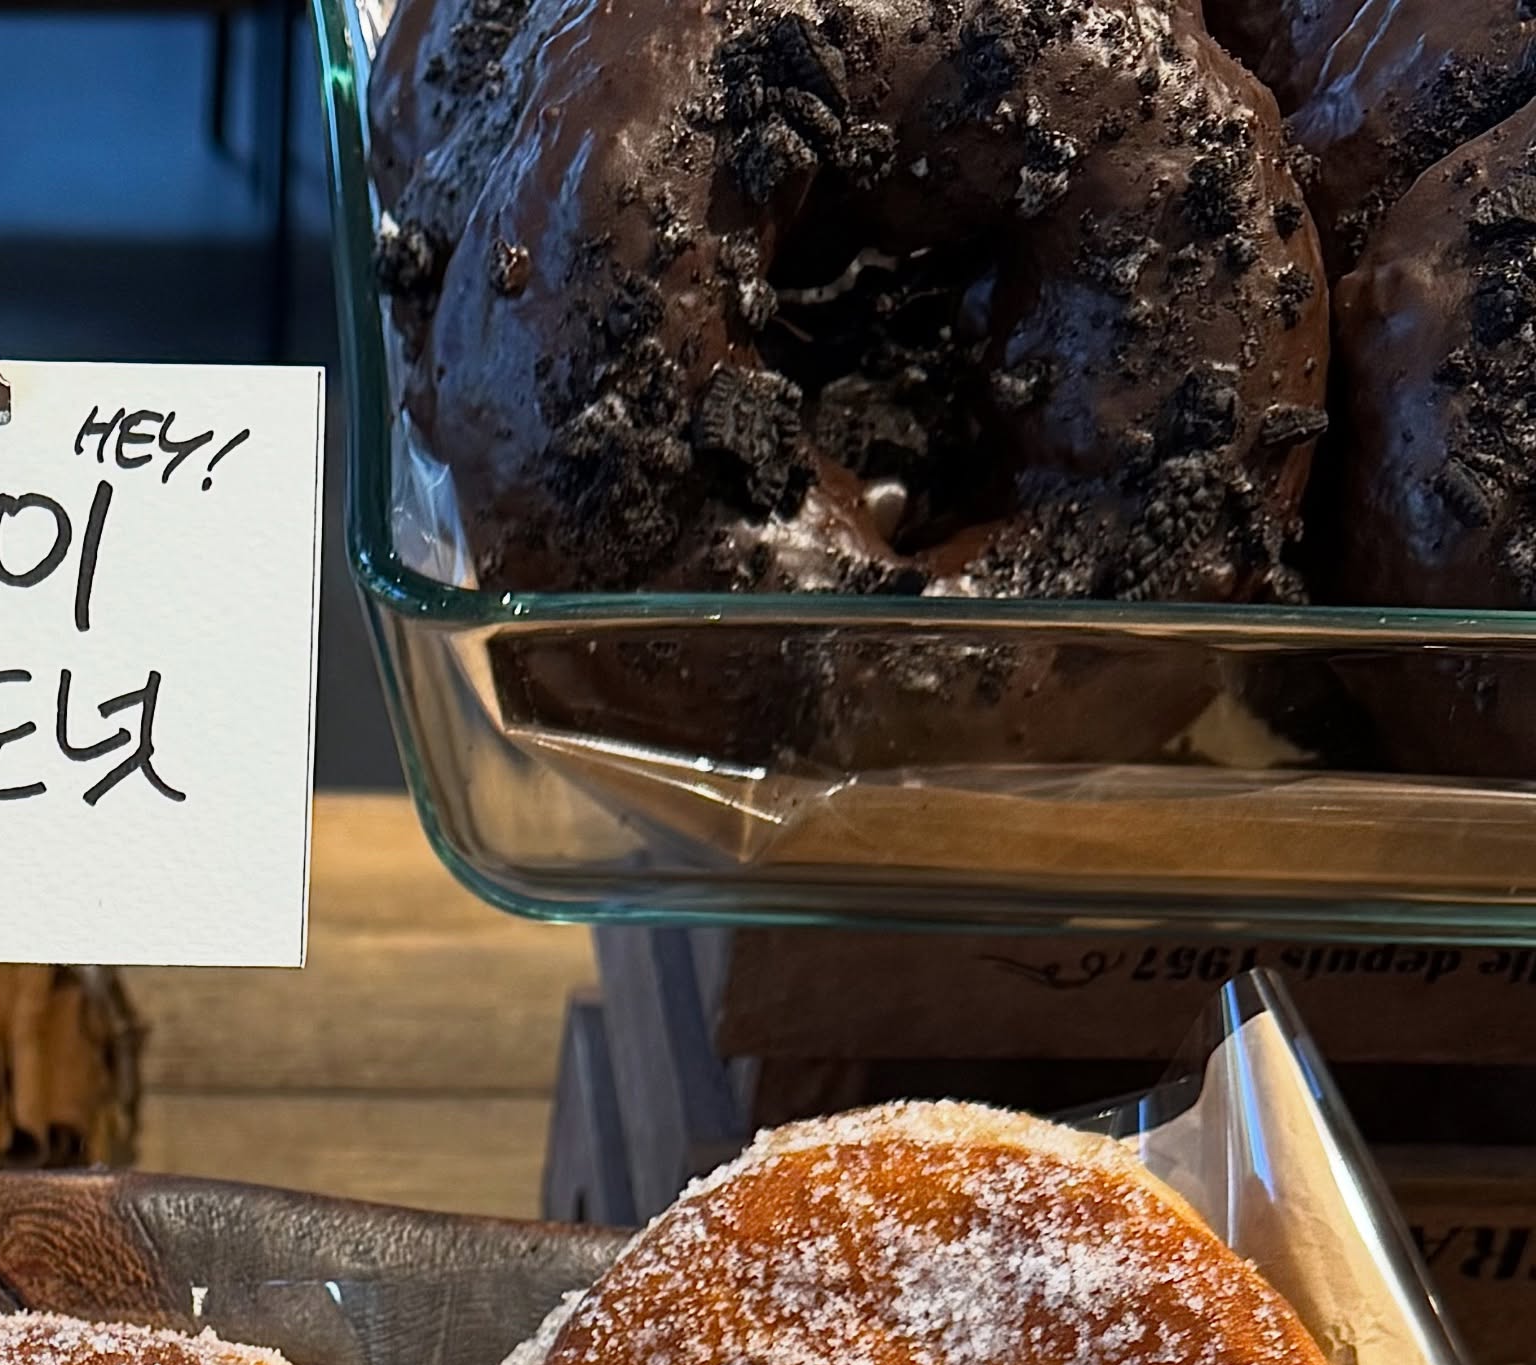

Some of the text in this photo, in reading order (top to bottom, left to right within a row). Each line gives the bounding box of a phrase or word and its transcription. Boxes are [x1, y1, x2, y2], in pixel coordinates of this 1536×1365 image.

[74, 405, 251, 490] HEY!
[1130, 946, 1259, 982] 1957
[1280, 943, 1462, 986] depuis
